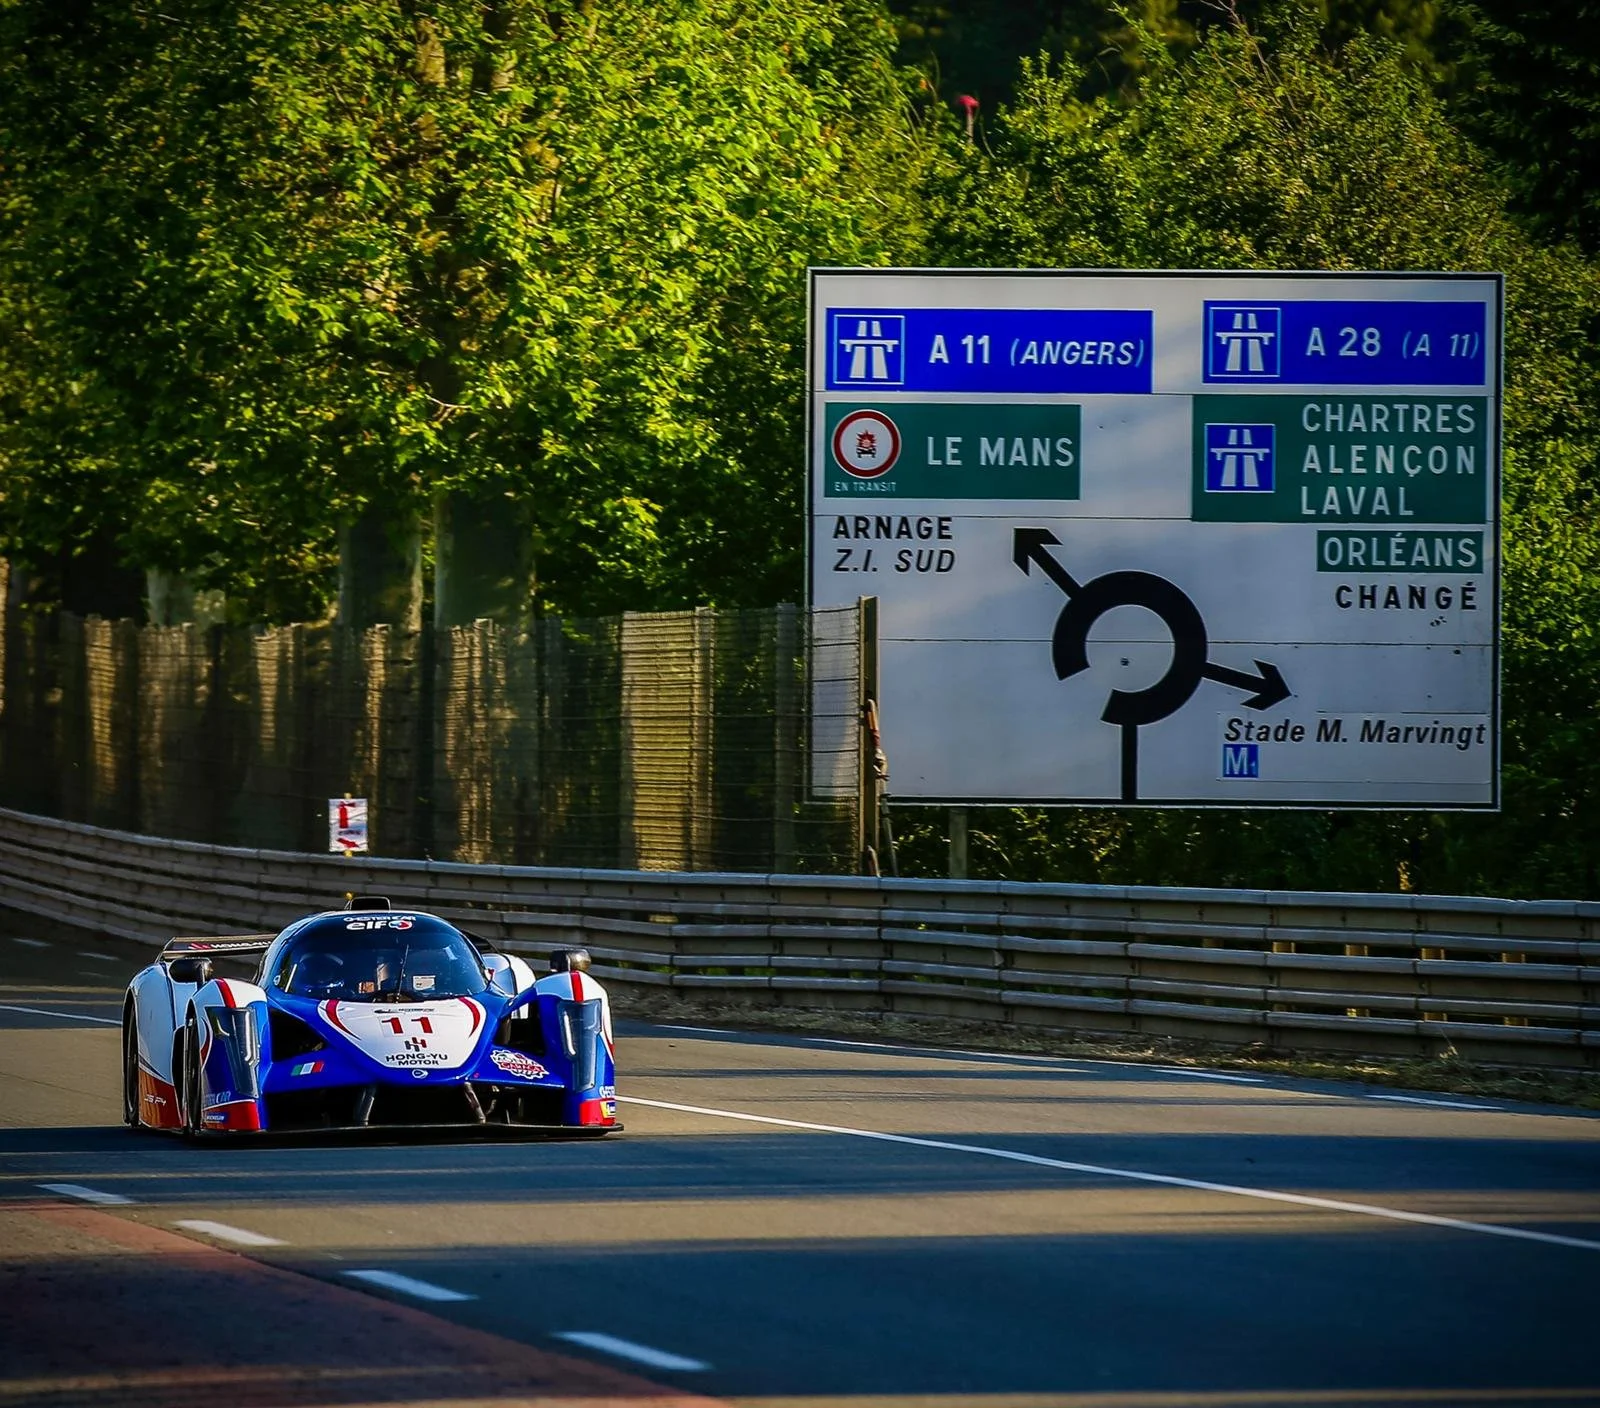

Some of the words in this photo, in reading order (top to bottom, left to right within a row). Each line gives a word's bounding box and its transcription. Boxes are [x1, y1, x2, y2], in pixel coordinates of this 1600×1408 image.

[929, 335, 949, 364] A
[961, 335, 990, 364] 11
[1010, 338, 1144, 368] (ANGERS)
[1306, 327, 1326, 356] A
[1339, 327, 1381, 357] 28
[1402, 331, 1431, 359] (A
[1449, 332, 1479, 359] 11)
[1302, 403, 1475, 433] CHARTRES
[927, 436, 963, 465] LE
[979, 437, 1074, 467] MANS
[1302, 444, 1475, 477] ALENÇON
[834, 481, 849, 492] EN
[853, 481, 897, 492] TRANSIT
[1301, 486, 1414, 516] LAVAL
[833, 515, 953, 540] ARNAGE
[833, 549, 878, 573] Z.I.
[894, 549, 956, 573] SUD
[1323, 532, 1476, 567] ORLÉANS
[1335, 581, 1477, 610] CHANGÉ
[1224, 717, 1305, 743] Stade
[1315, 719, 1348, 743] M.
[1359, 719, 1487, 751] Marvingt
[381, 1016, 434, 1034] 11
[385, 1052, 448, 1062] HONG-YU
